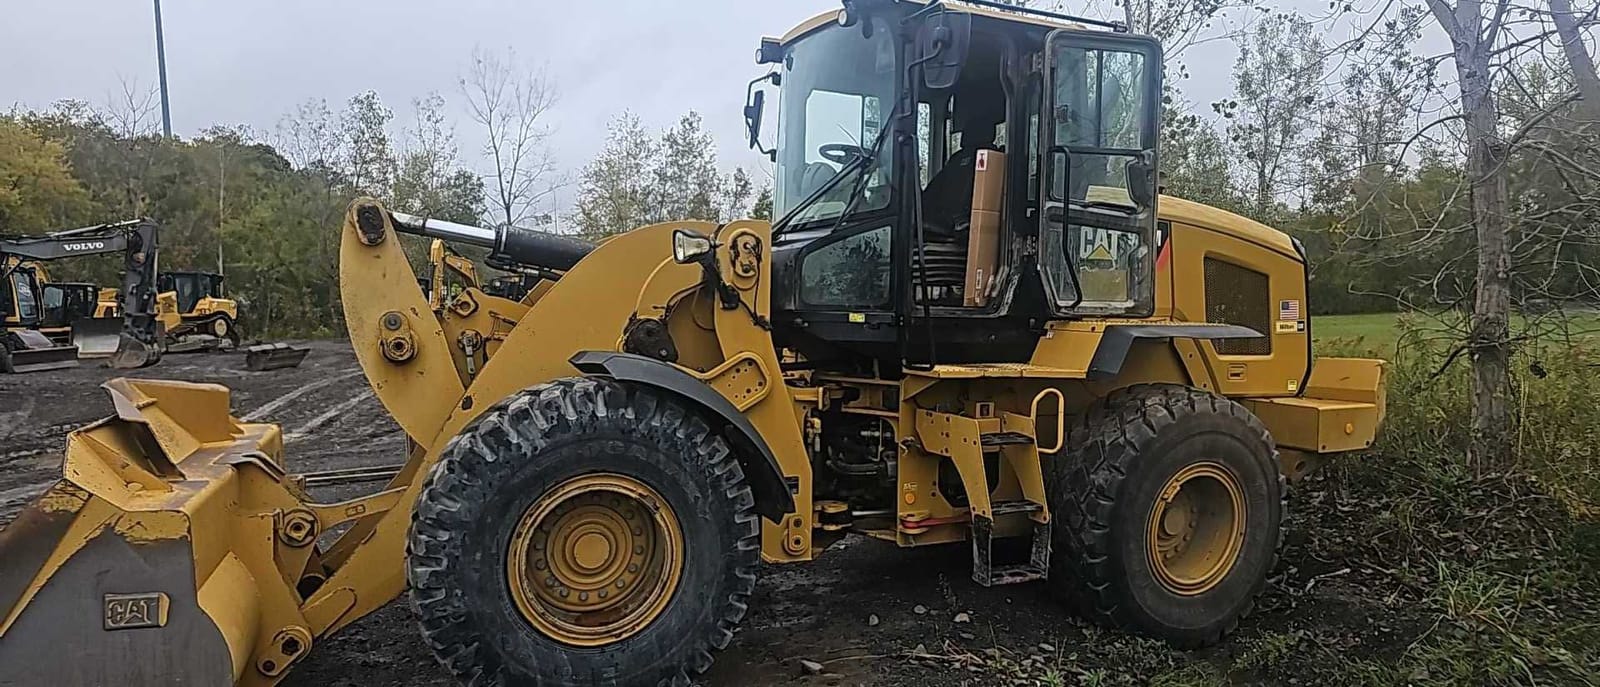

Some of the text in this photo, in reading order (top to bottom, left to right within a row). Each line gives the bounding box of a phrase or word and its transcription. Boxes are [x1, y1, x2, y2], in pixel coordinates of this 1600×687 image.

[63, 241, 104, 251] VOLVO
[1080, 226, 1121, 260] CAT
[107, 599, 157, 626] CAT
